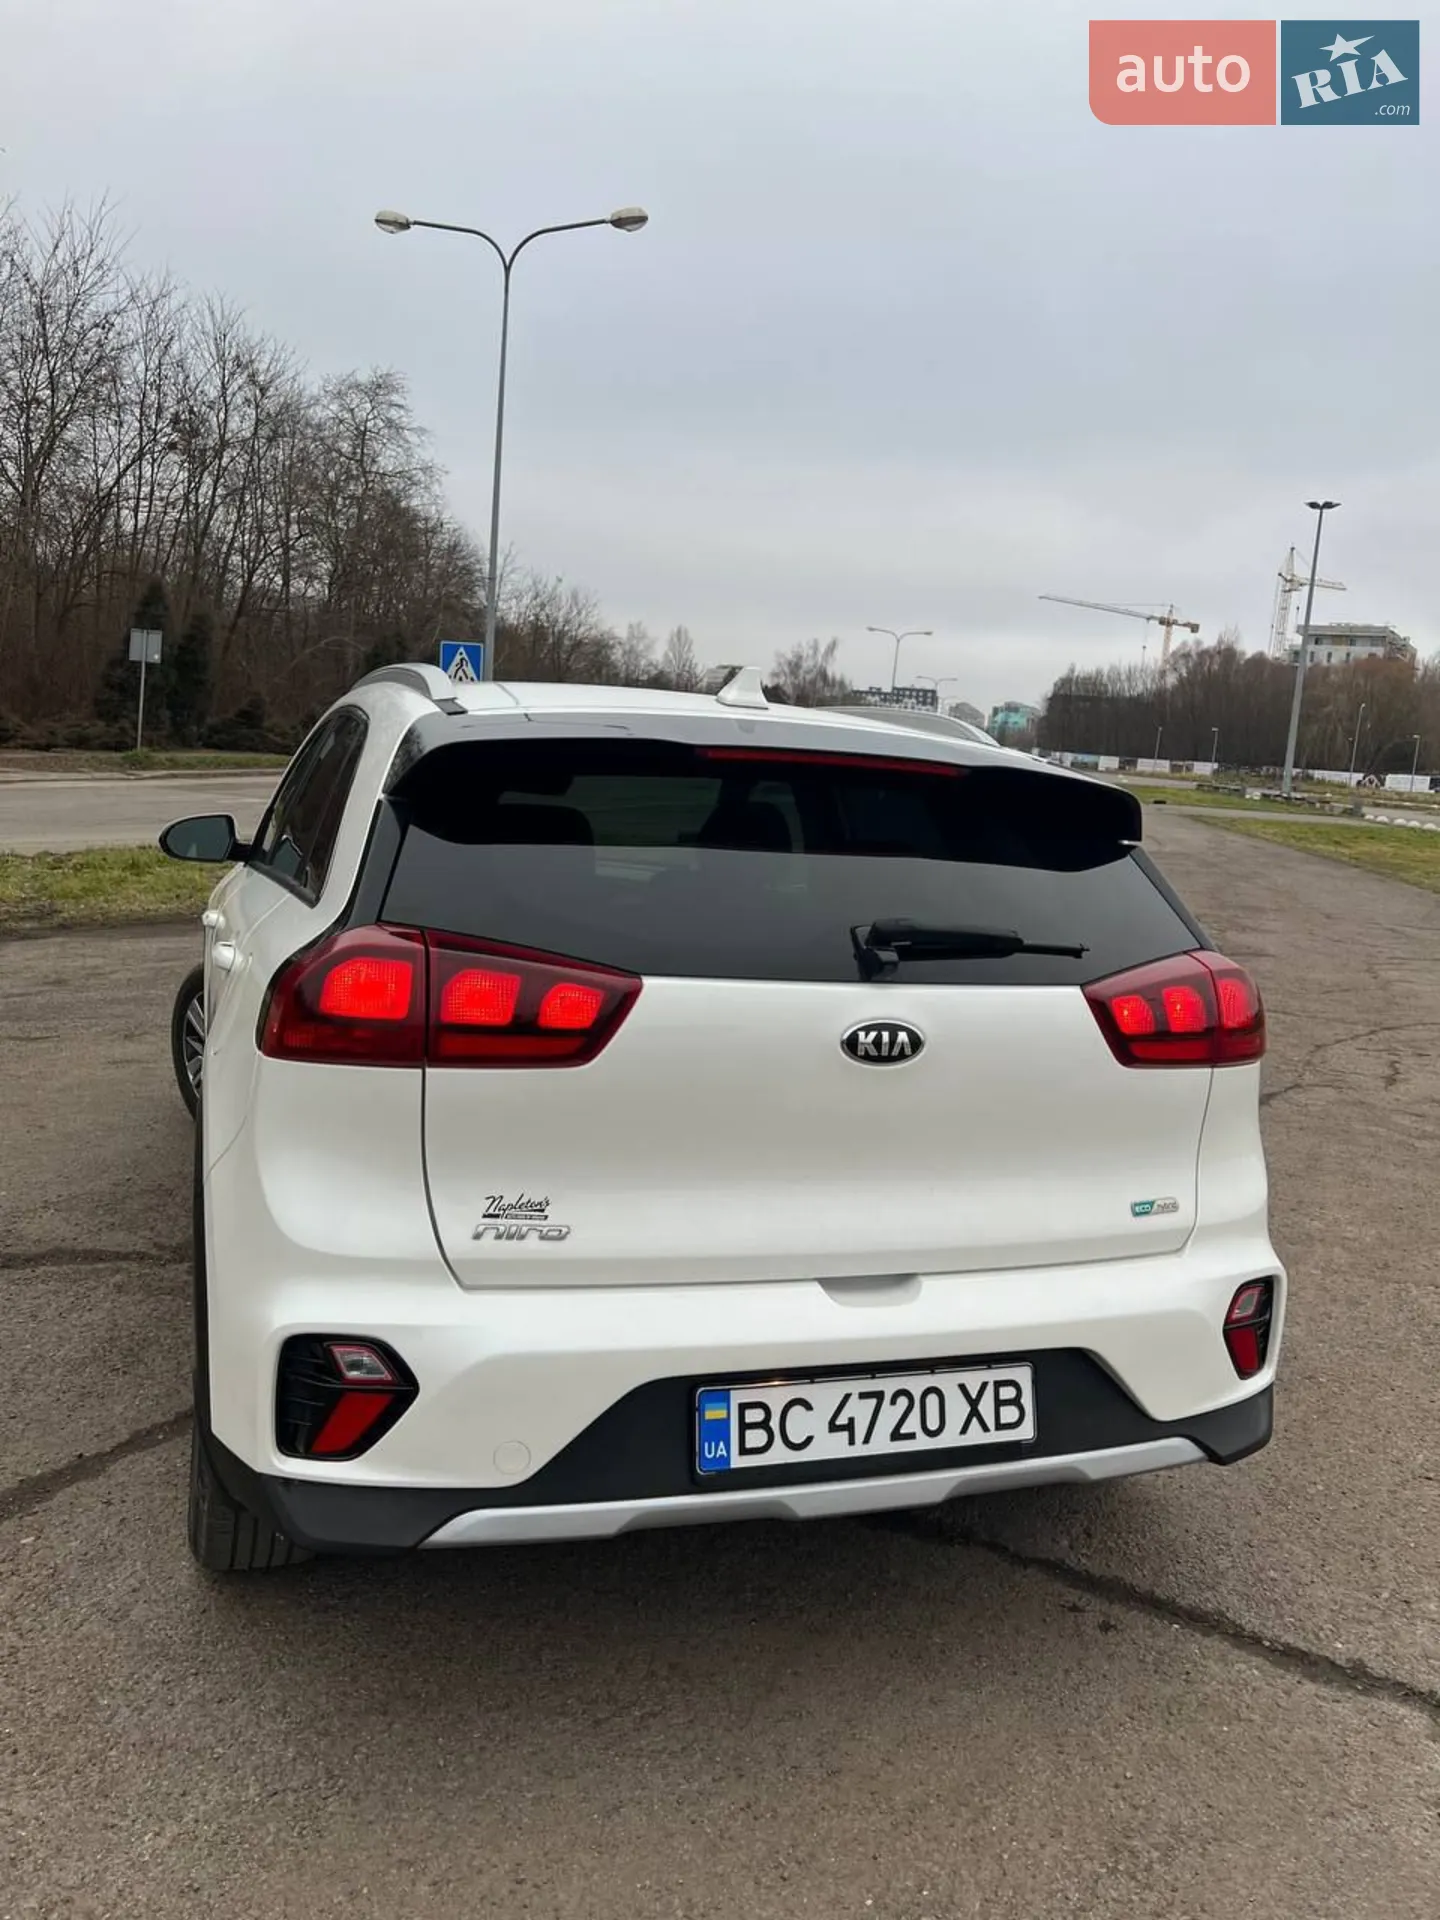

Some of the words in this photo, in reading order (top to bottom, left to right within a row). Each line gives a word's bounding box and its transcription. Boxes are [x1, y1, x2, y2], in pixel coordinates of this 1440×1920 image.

[857, 1030, 912, 1056] KIA
[738, 1398, 815, 1457] BC
[827, 1385, 946, 1447] 4720
[957, 1379, 1026, 1436] XB
[704, 1441, 727, 1459] UA
